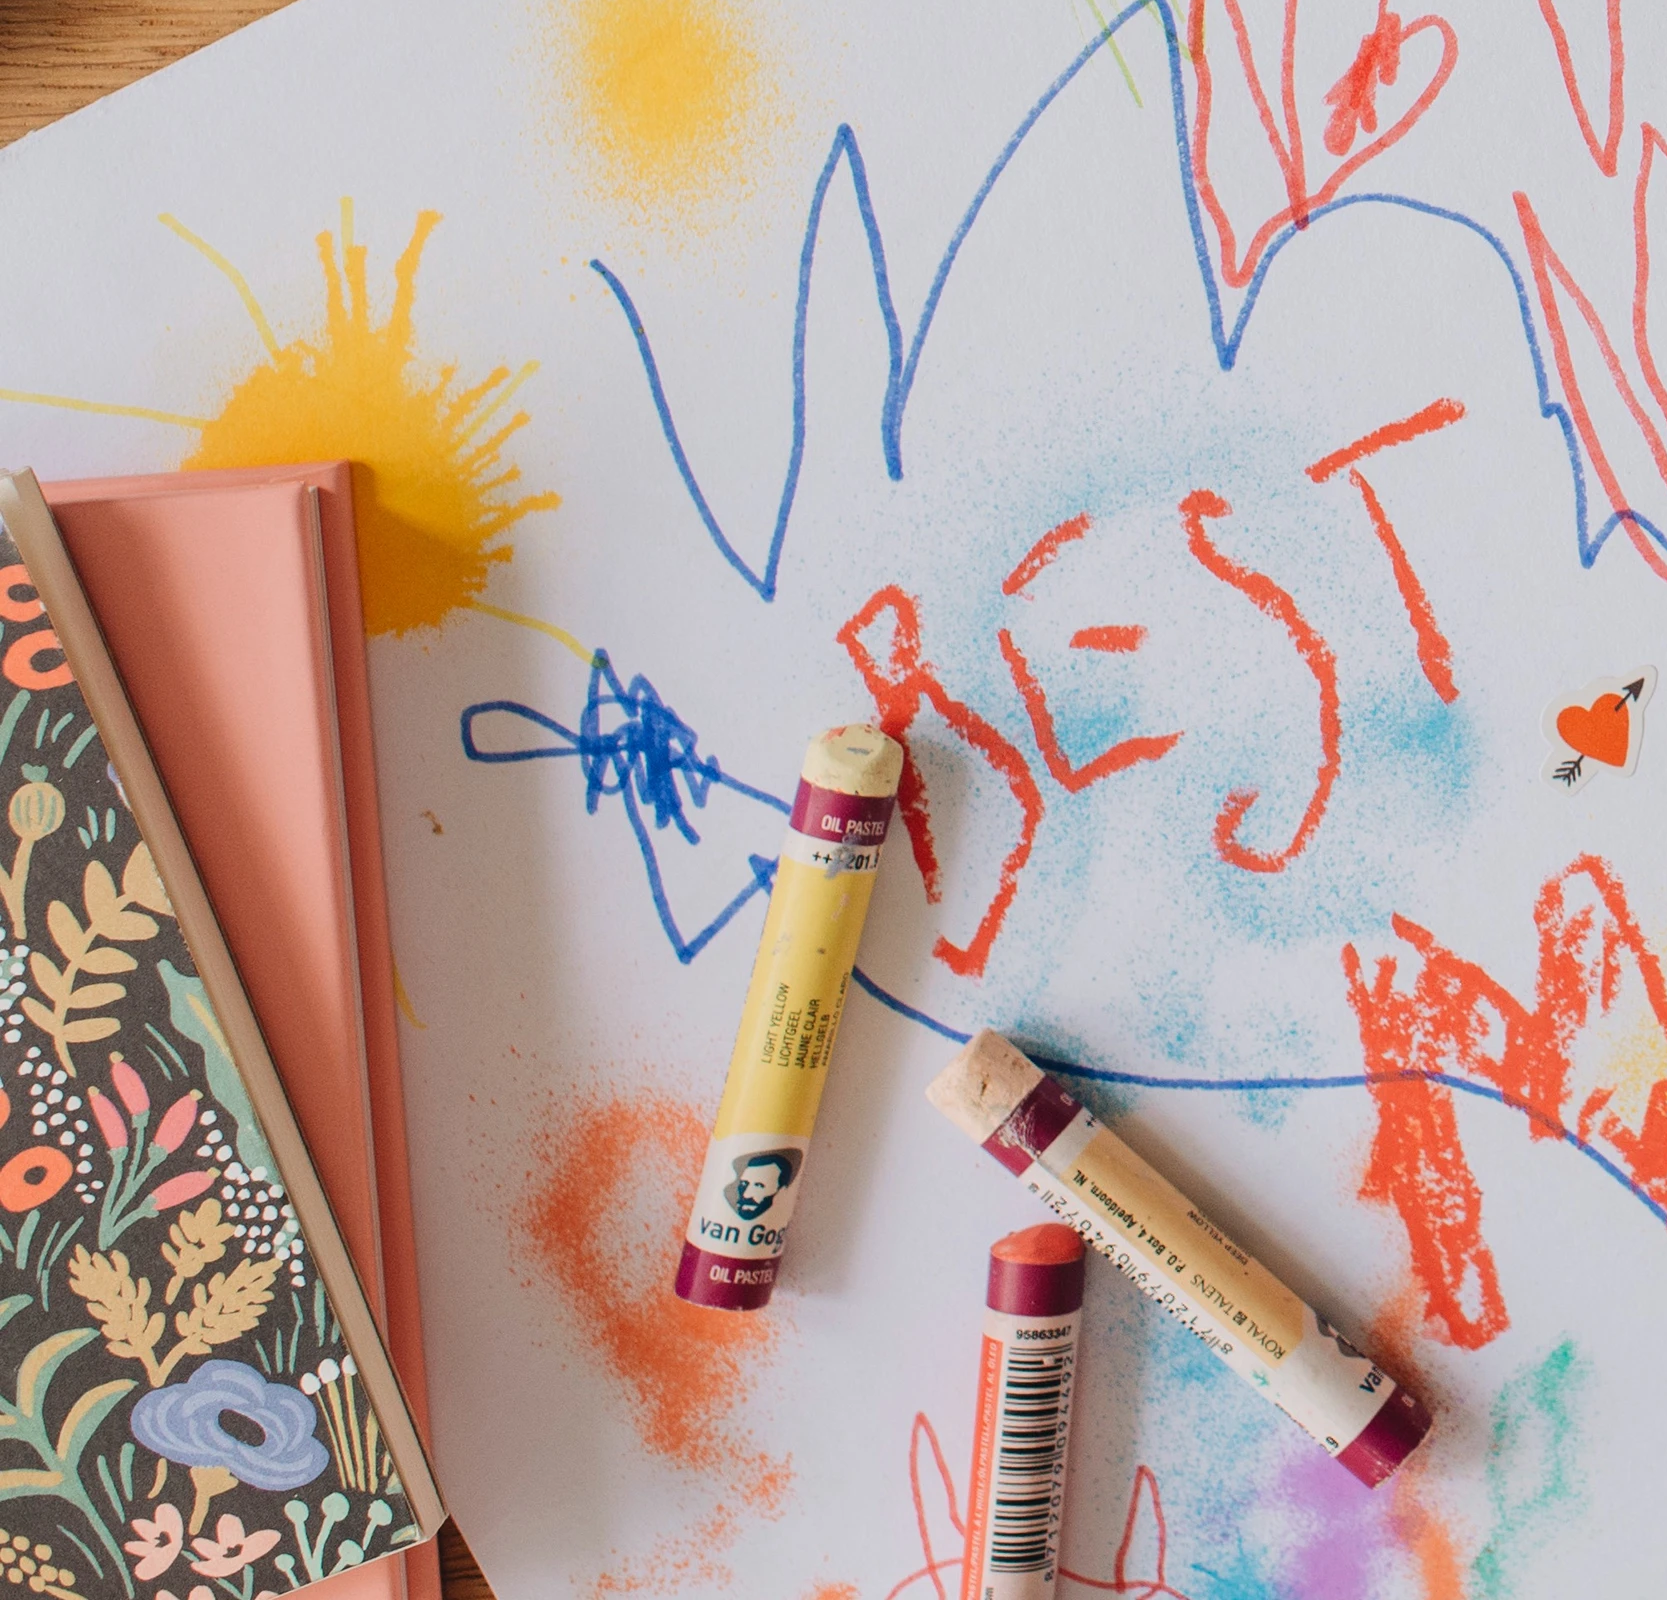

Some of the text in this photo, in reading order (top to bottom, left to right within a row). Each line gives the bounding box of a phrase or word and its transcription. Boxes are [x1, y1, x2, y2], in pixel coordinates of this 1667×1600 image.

[820, 814, 884, 834] OIL PASTEL
[760, 982, 790, 1064] LIGHT YELLOW
[777, 1007, 801, 1067] LICHTGEEL
[793, 997, 820, 1068] JAUNE CLAIR
[808, 1013, 830, 1069] HELLGELB
[1070, 1168, 1089, 1186] NL
[1084, 1180, 1138, 1230] Apeldoorn,
[697, 1216, 742, 1243] van
[1143, 1233, 1167, 1255] Box
[1184, 1208, 1226, 1245] YELLOW
[1161, 1249, 1187, 1273] P.O.
[1222, 1240, 1249, 1266] DEEP
[708, 1264, 733, 1283] OIL
[1188, 1272, 1235, 1315] TALENS
[1243, 1319, 1287, 1360] ROYAL
